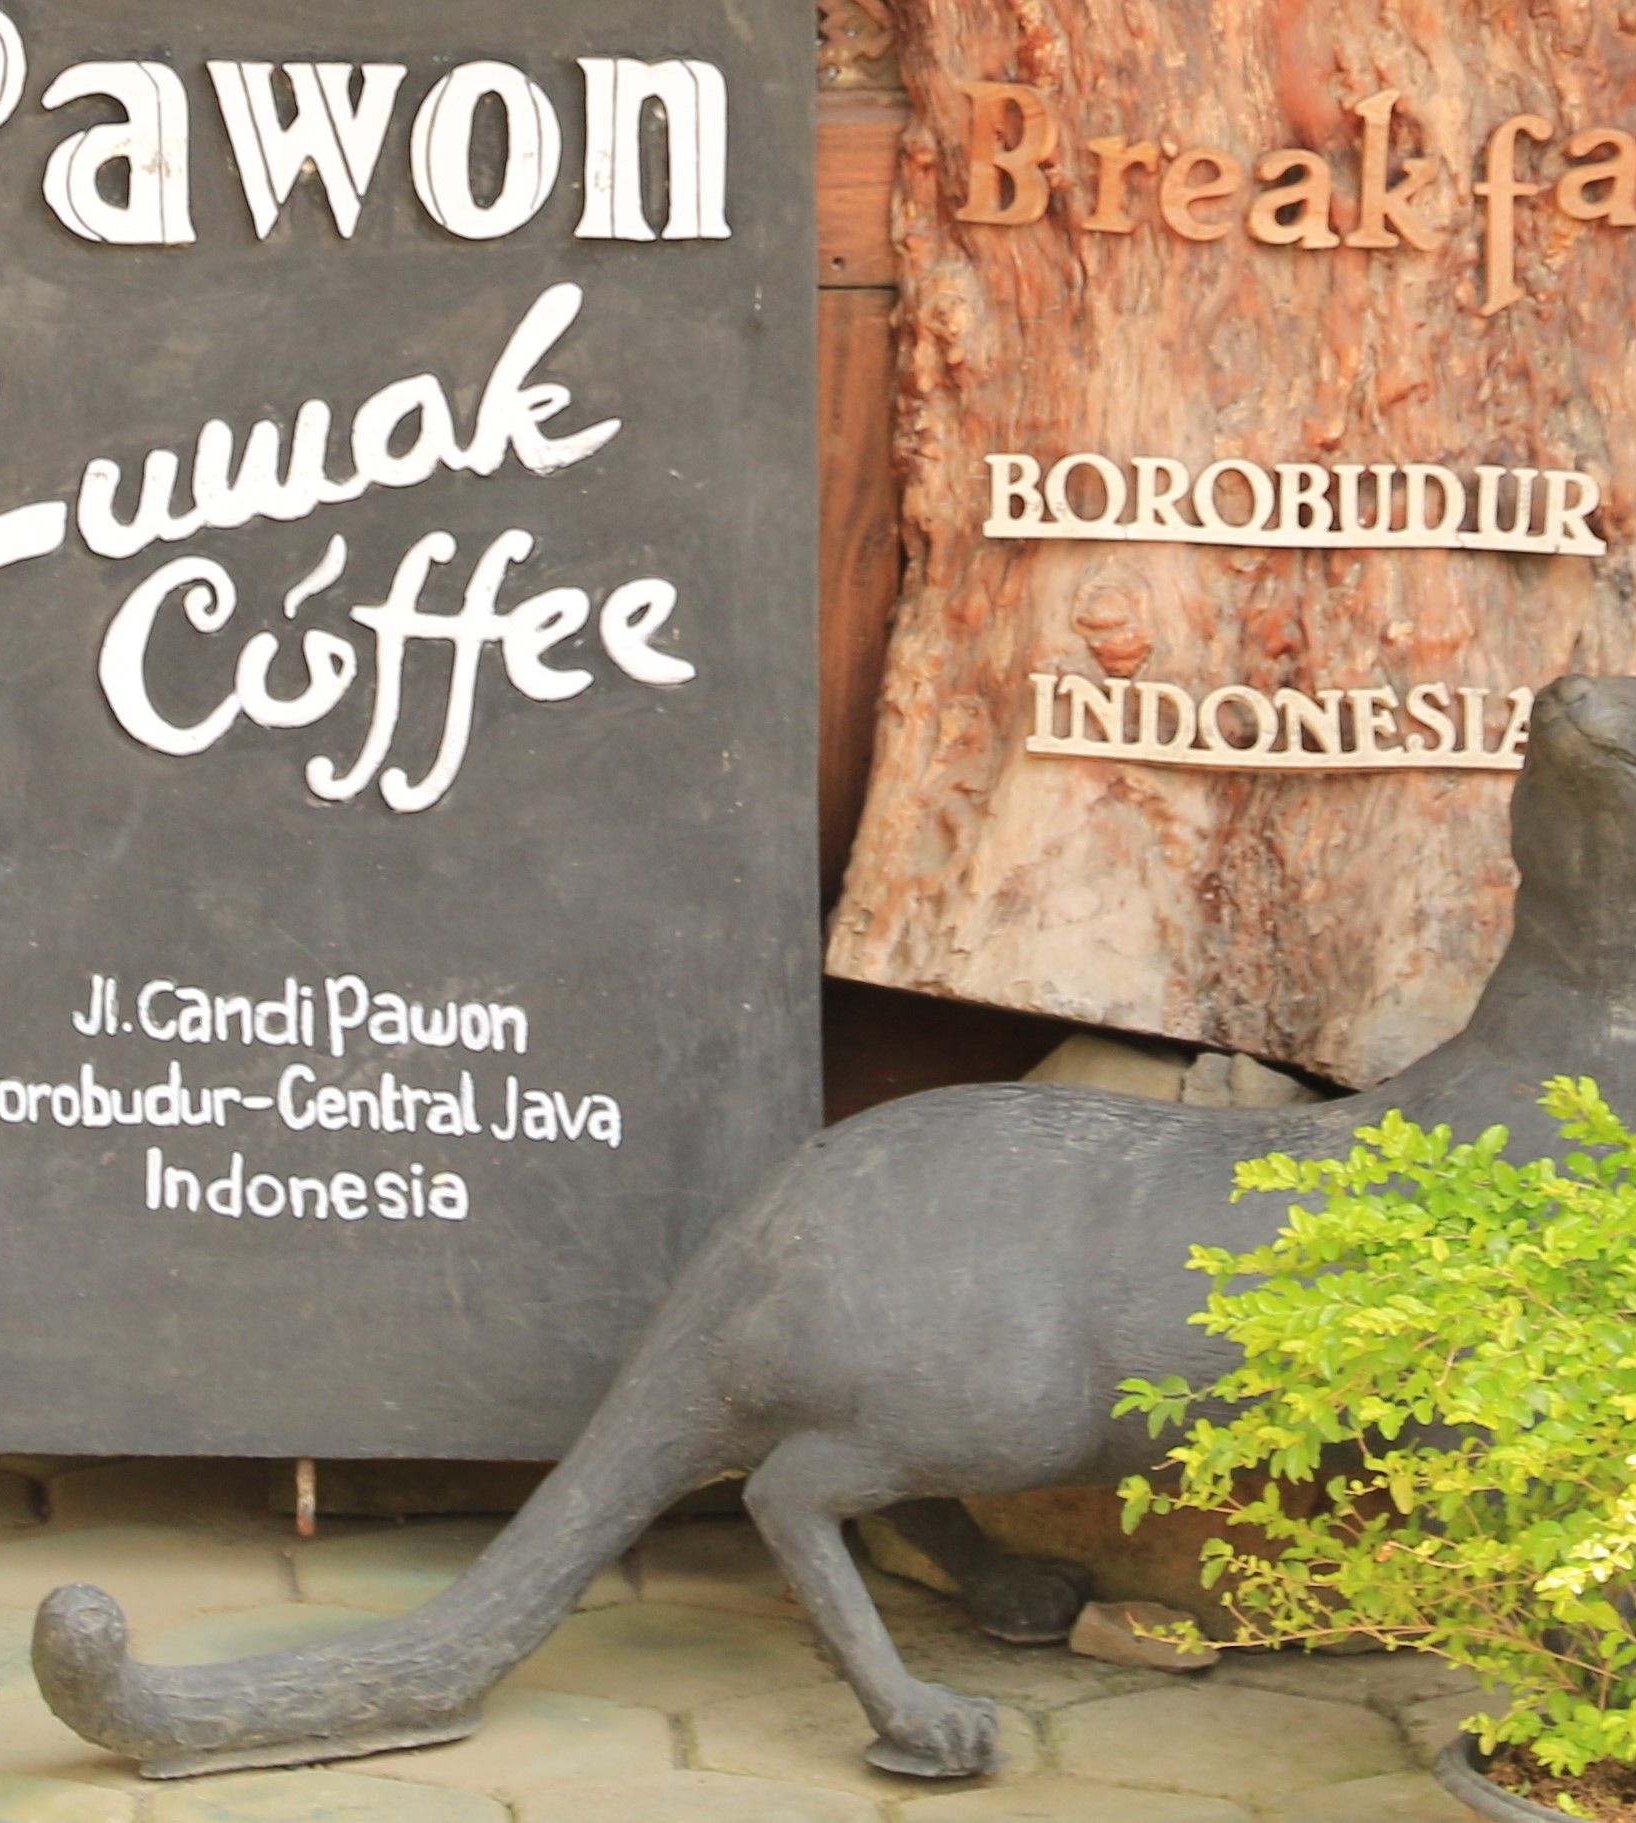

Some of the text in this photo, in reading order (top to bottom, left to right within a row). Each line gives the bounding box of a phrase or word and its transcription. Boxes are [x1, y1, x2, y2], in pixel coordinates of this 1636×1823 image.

[981, 452, 1606, 557] BOROBUDUR
[137, 979, 315, 1048] Candi
[327, 976, 528, 1058] Pawon
[490, 1074, 624, 1149] Java
[144, 1146, 469, 1222] Indonesia
